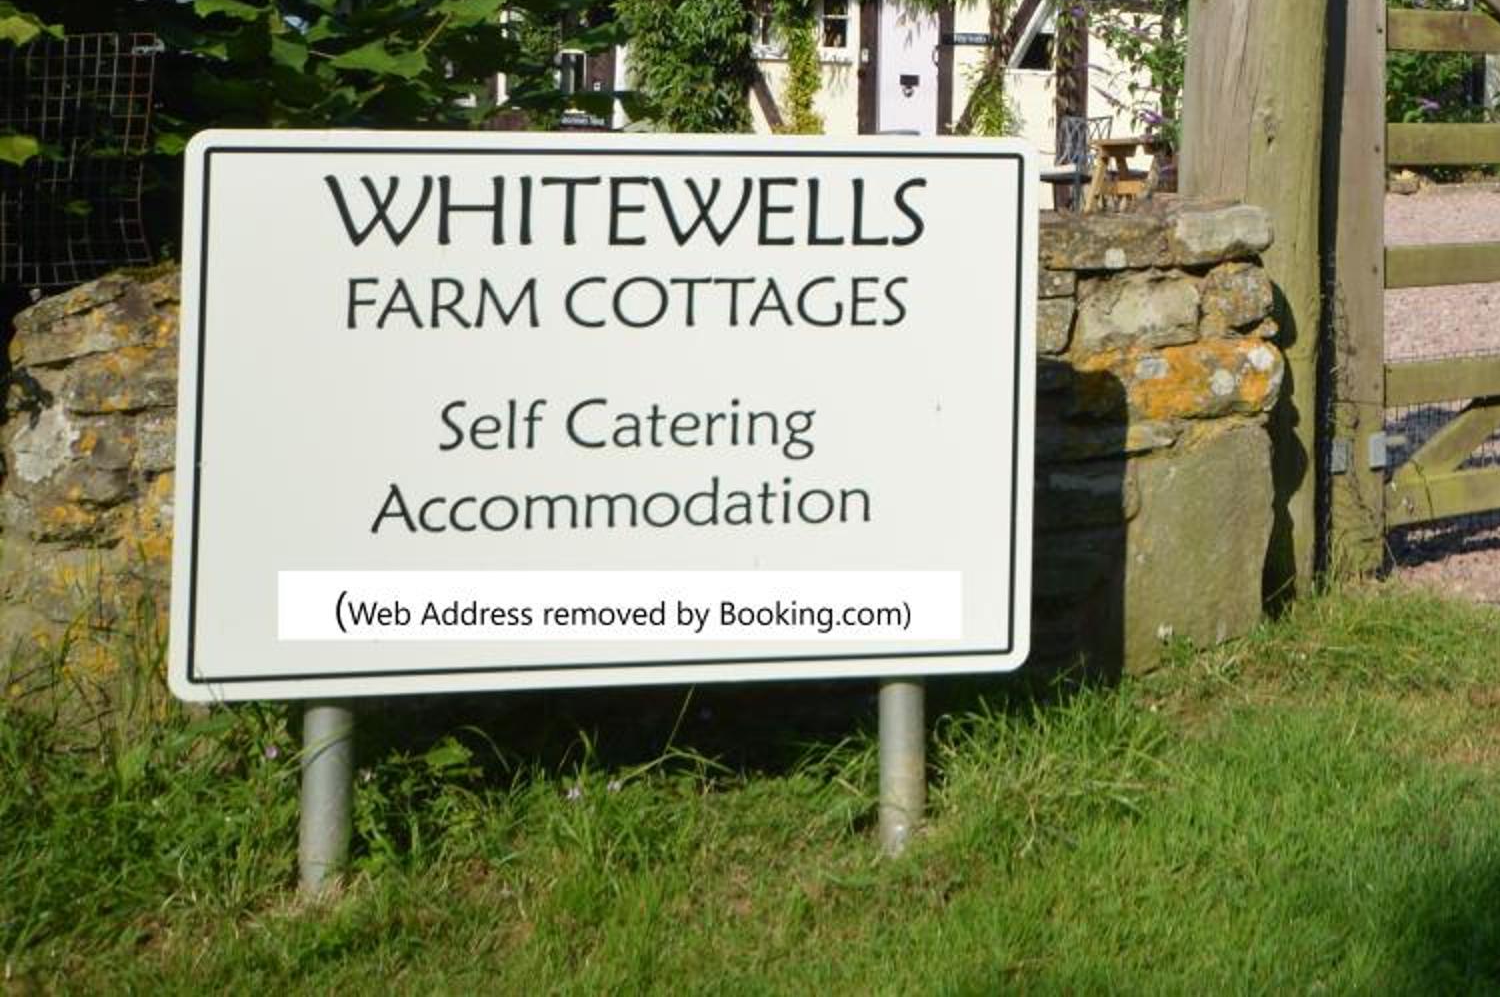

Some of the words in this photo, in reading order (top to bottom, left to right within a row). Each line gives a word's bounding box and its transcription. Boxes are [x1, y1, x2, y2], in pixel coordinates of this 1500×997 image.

[324, 174, 927, 247] WHITEWELLS
[347, 277, 539, 329] FARM
[565, 276, 908, 328] COTTAGES
[439, 399, 547, 451] Self
[566, 398, 816, 460] Catering
[371, 476, 872, 534] Accommodation
